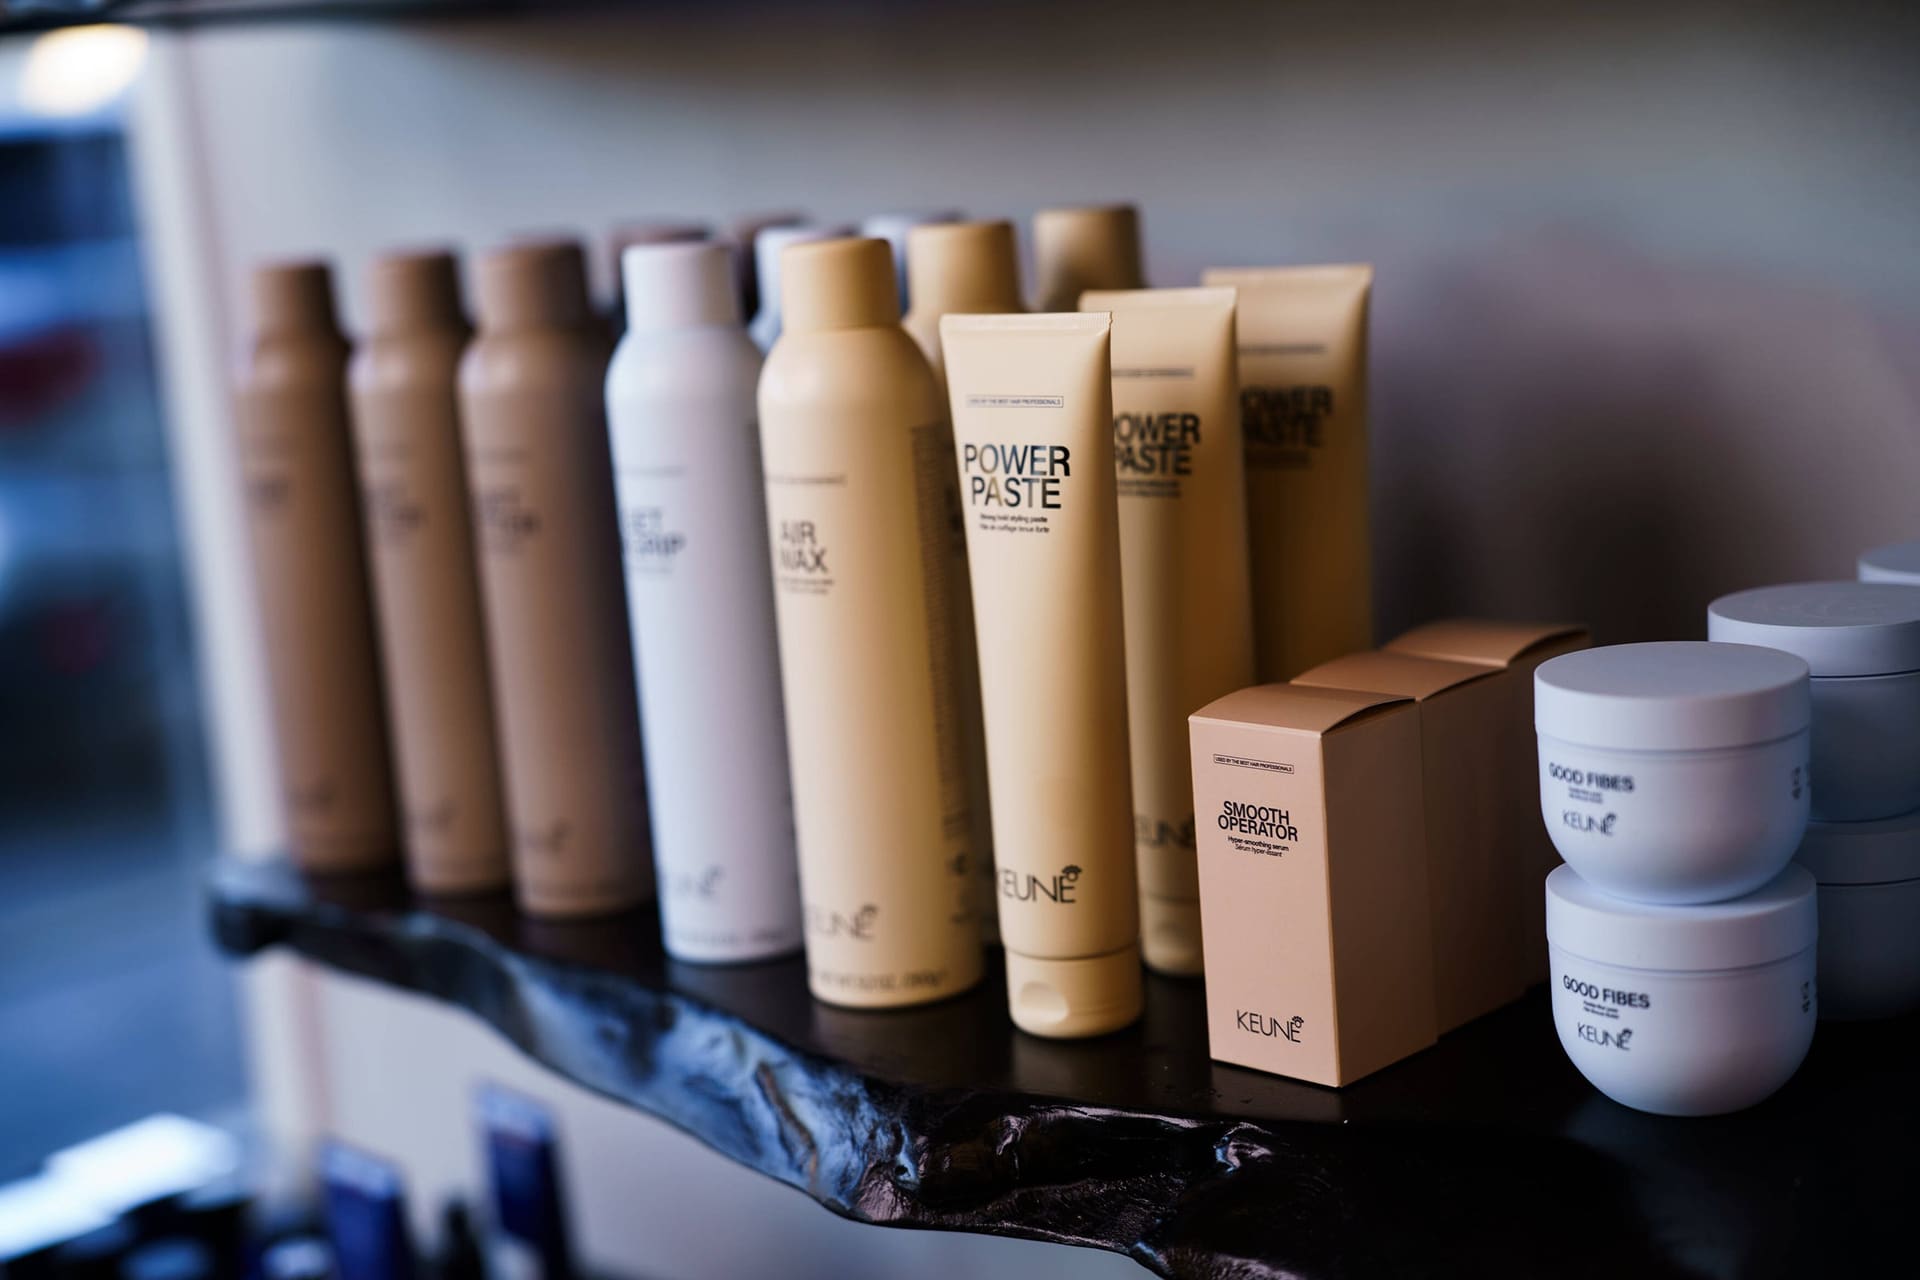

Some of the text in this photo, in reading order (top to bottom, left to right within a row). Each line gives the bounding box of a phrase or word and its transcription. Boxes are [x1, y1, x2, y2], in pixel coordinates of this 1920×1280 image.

[1113, 413, 1201, 444] OWER
[964, 443, 1071, 477] POWER
[971, 476, 1062, 509] PASTE
[1548, 762, 1584, 785] GOOD
[1586, 772, 1635, 793] FIBES
[1217, 814, 1298, 842] OPERATOR
[1223, 800, 1290, 826] SMOOTH
[1562, 810, 1617, 836] KEUNE
[1563, 974, 1599, 1000] GOOD
[1602, 988, 1650, 1010] FIBES
[1236, 1009, 1304, 1044] KEUNE
[1577, 1021, 1633, 1051] KEUNE
